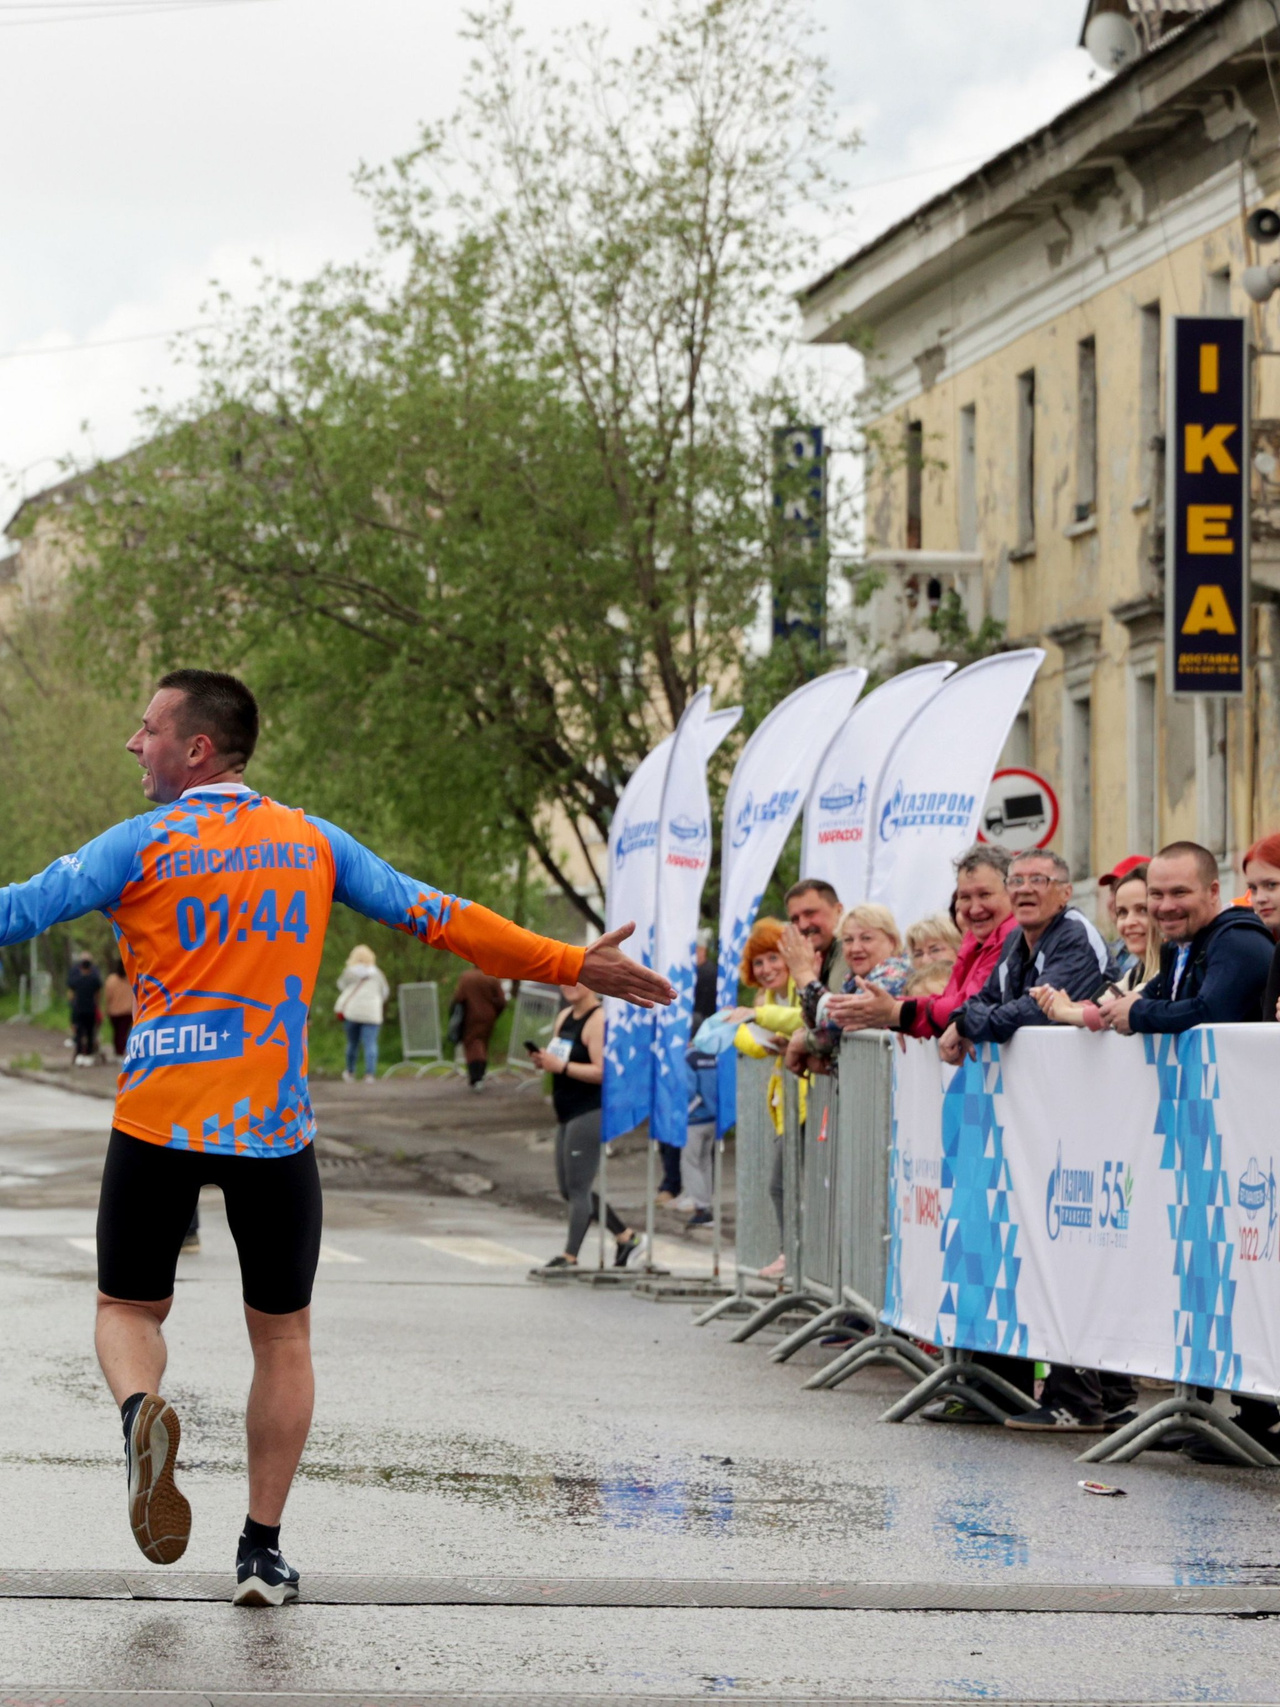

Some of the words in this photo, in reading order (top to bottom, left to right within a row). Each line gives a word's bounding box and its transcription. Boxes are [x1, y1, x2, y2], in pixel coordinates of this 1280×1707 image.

[1181, 344, 1240, 635] IKEA
[900, 793, 975, 814] ГАЗПРОМ
[155, 838, 318, 881] ПЕЙСМЕЙКЕР
[176, 888, 310, 952] 01:44
